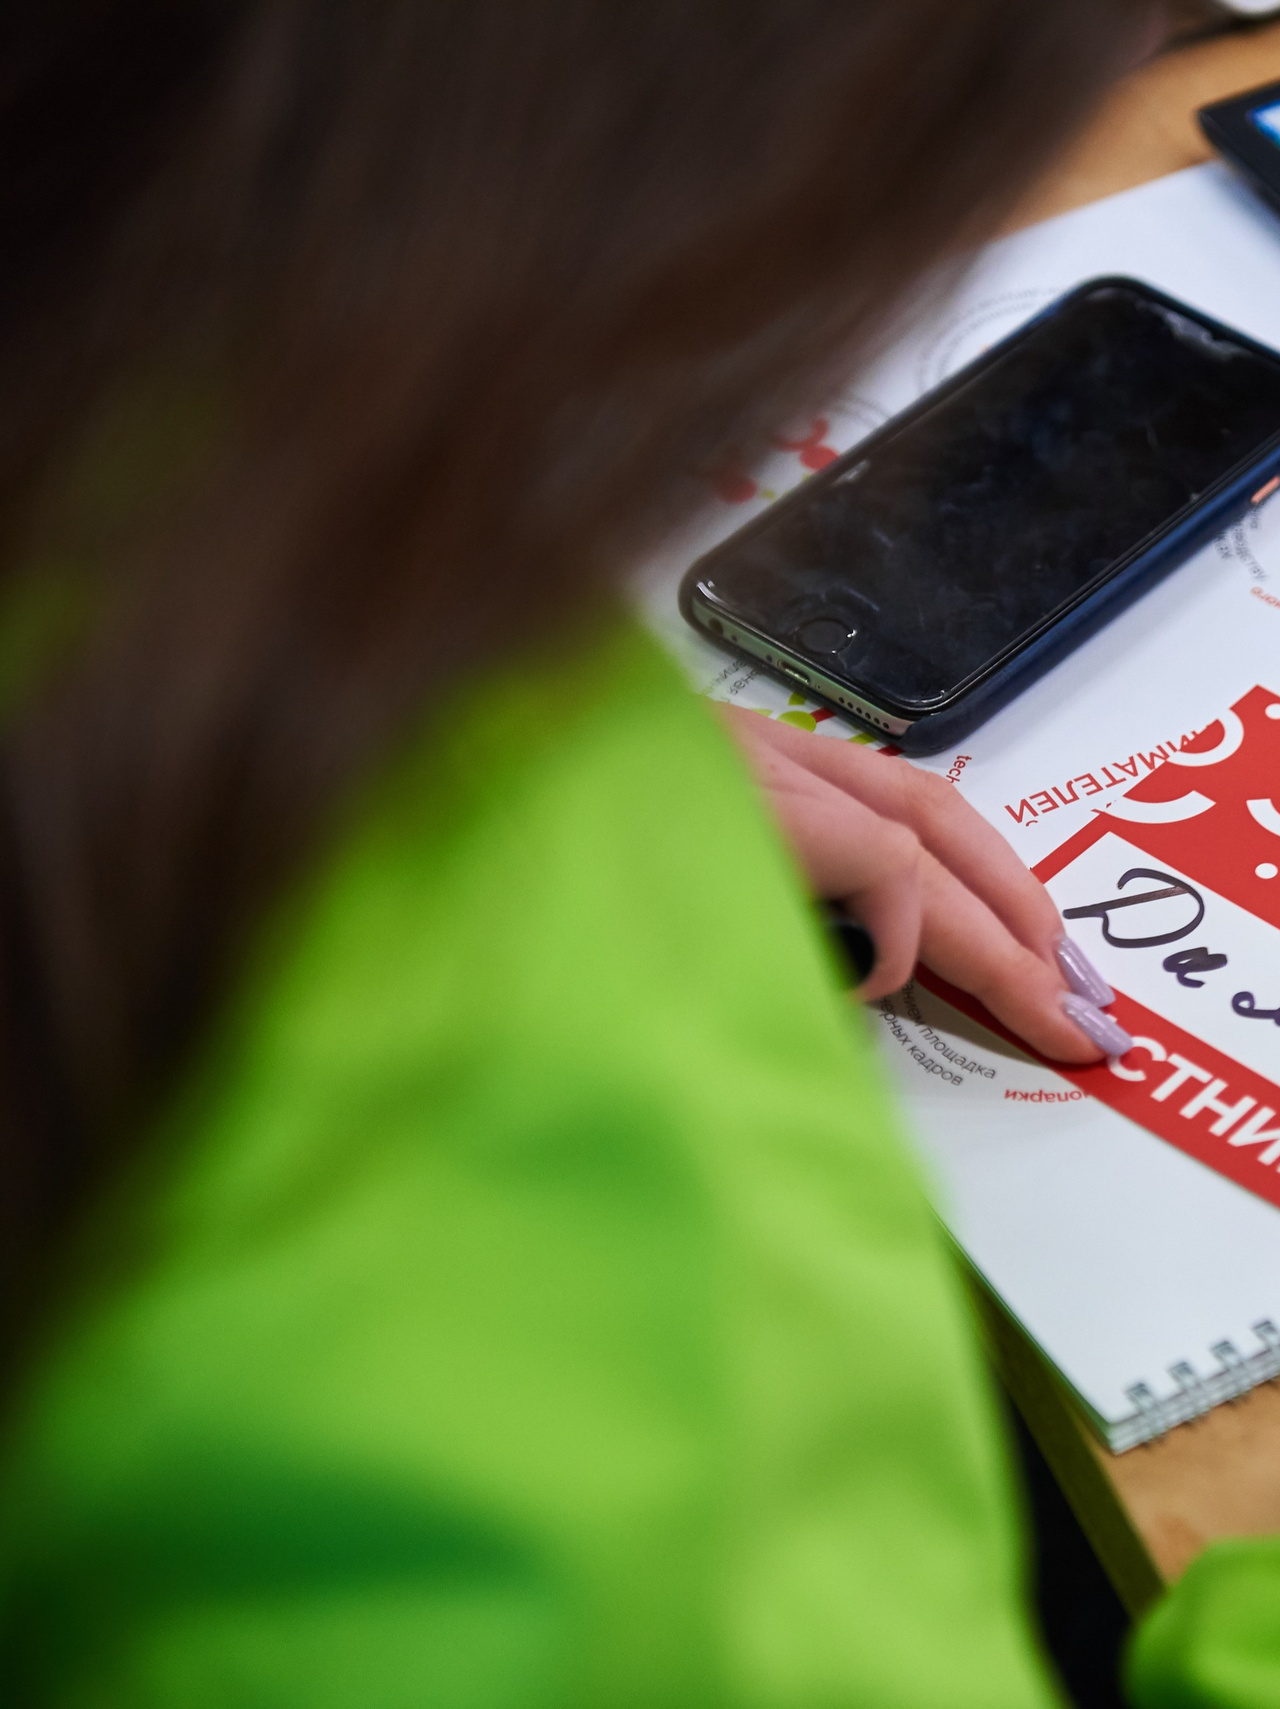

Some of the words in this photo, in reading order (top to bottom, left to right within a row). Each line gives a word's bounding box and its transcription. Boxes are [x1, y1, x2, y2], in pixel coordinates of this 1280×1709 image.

[946, 754, 972, 783] tech
[1004, 731, 1196, 827] ИМАТЕЛЕЙ
[908, 1044, 964, 1087] кадров
[918, 1026, 997, 1079] площадка
[1004, 1088, 1084, 1103] опарки
